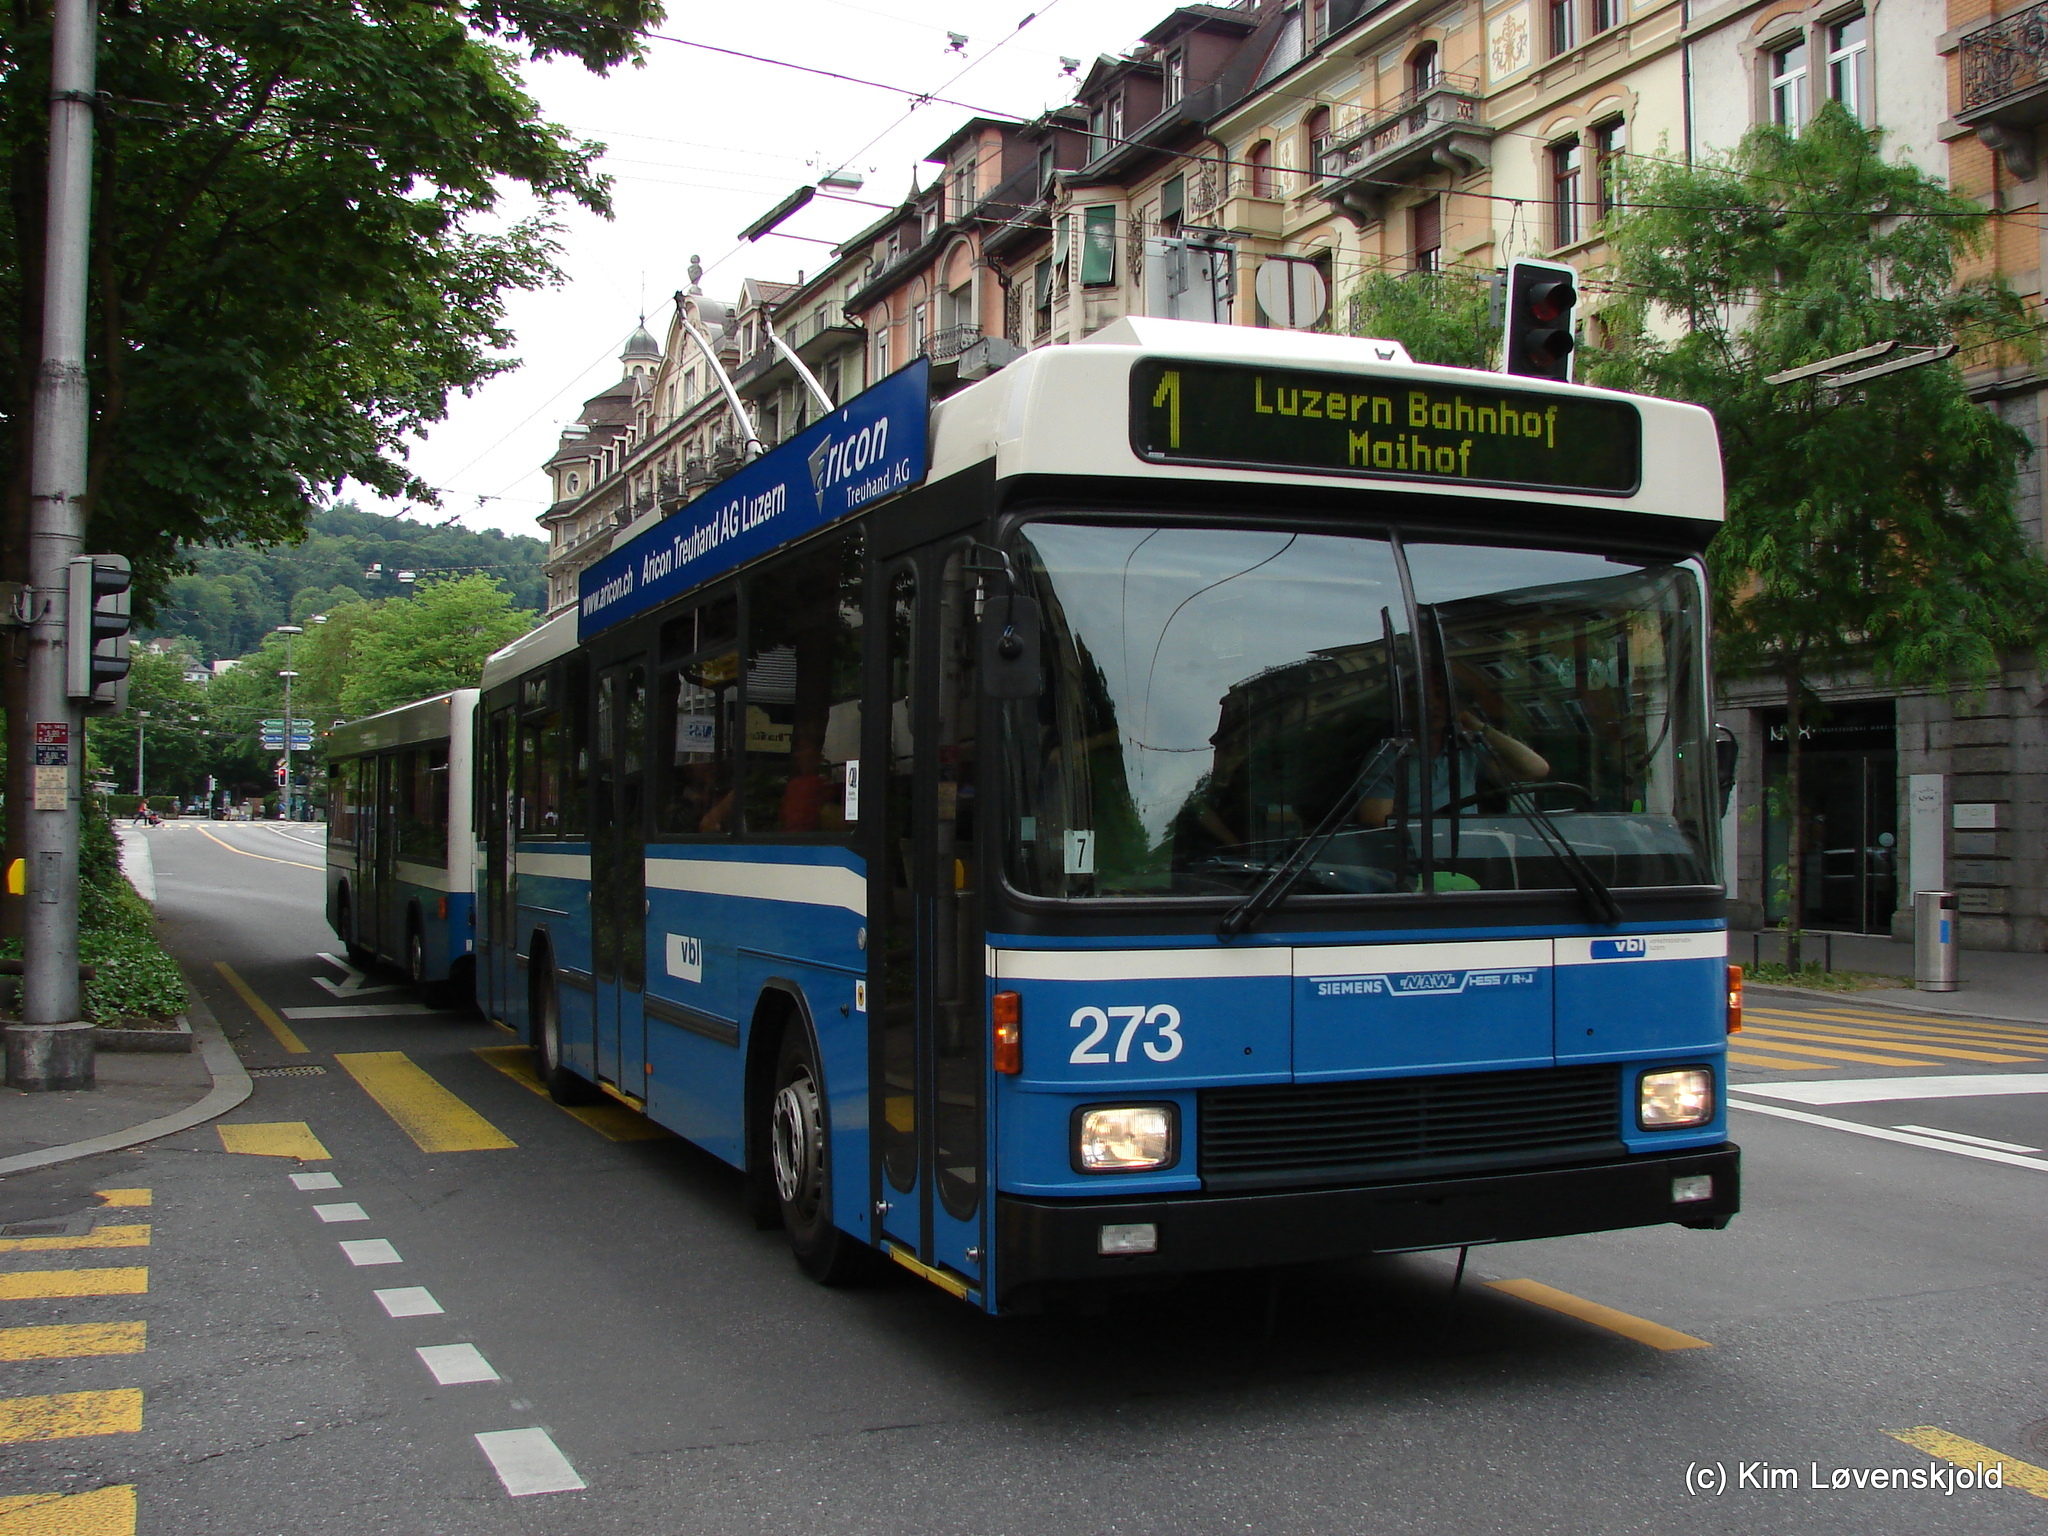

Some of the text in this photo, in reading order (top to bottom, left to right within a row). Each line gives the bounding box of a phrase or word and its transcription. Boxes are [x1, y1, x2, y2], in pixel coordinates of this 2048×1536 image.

[1153, 371, 1558, 449] 1 Luzern Bahnhof
[1349, 429, 1473, 477] Maihof
[847, 458, 910, 507] Treuhand AG
[583, 482, 786, 617] www.aricon.ch Aricon Treuhand AG Luzern
[1077, 838, 1087, 868] 7
[681, 937, 700, 967] vbl
[1614, 938, 1645, 952] vbl
[1318, 981, 1382, 996] SIEMENS
[1402, 973, 1454, 990] NAW
[1469, 975, 1500, 986] HESS
[1069, 1004, 1183, 1064] 273
